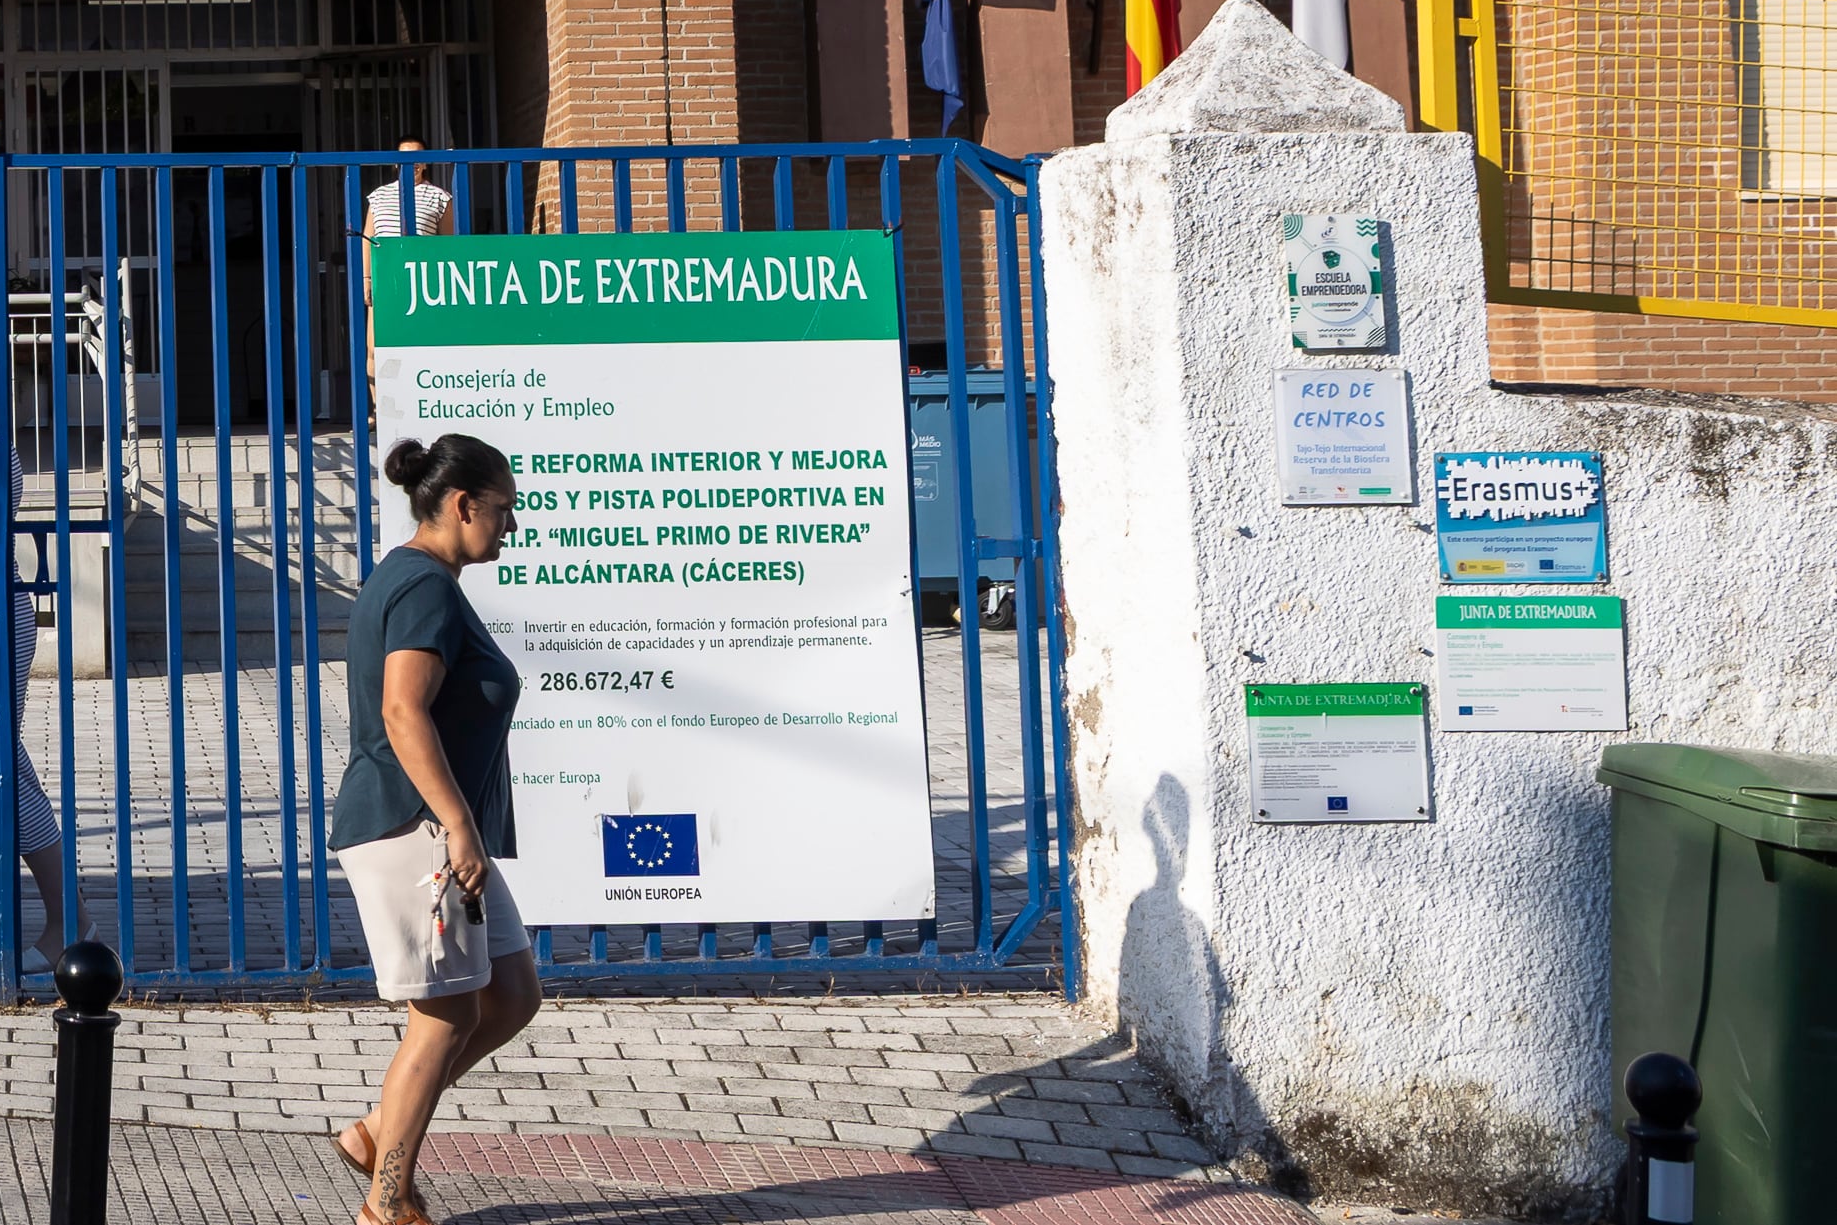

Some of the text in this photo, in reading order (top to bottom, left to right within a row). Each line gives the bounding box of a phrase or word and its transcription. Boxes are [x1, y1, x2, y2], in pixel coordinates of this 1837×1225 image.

[404, 255, 868, 315] JUNTA DE EXTREMADURA
[1315, 272, 1351, 284] ESCUELA
[1301, 284, 1367, 296] EMPRENDEDORA
[416, 368, 546, 392] Consejería de
[1301, 382, 1375, 398] RED DE
[418, 397, 615, 421] Educación y Empleo
[1293, 409, 1385, 428] CENTROS
[1296, 444, 1386, 454] Tajo-Tejo Internacional
[510, 450, 888, 474] E REFORMA INTERIOR Y MEJORA
[1293, 455, 1390, 464] Reserva de la Biosfera
[1310, 466, 1371, 474] Transfronteriza
[565, 490, 580, 510] Y
[589, 489, 655, 510] PISTA
[662, 487, 847, 509] POLIDEPORTIVA
[854, 486, 884, 506] EN
[1453, 478, 1589, 502] Erasmus+
[657, 525, 730, 546] PRIMO
[739, 525, 768, 545] DE
[498, 558, 805, 588] DE ALCÁNTARA (CÁCERES)
[1459, 604, 1597, 621] JUNTA DE EXTREMADURA
[524, 620, 567, 633] Invertir
[571, 622, 585, 633] en
[589, 619, 651, 634] educación,
[656, 618, 714, 632] formación
[719, 620, 726, 632] y
[731, 617, 789, 630] formación
[793, 616, 857, 631] profesional
[862, 617, 888, 629] para
[524, 635, 872, 653] la adquisición de capacidades y un aprendizaje permanente.
[540, 671, 654, 693] 286.672,47
[660, 670, 675, 689] €
[1253, 694, 1411, 706] JUNTA DE EXTREMADURA
[510, 711, 898, 729] anciado en un 80% con el fondo Europeo de Desarrollo Regional
[523, 772, 555, 784] hacer
[559, 771, 601, 785] Europa
[605, 886, 702, 900] UNIÓN EUROPEA
